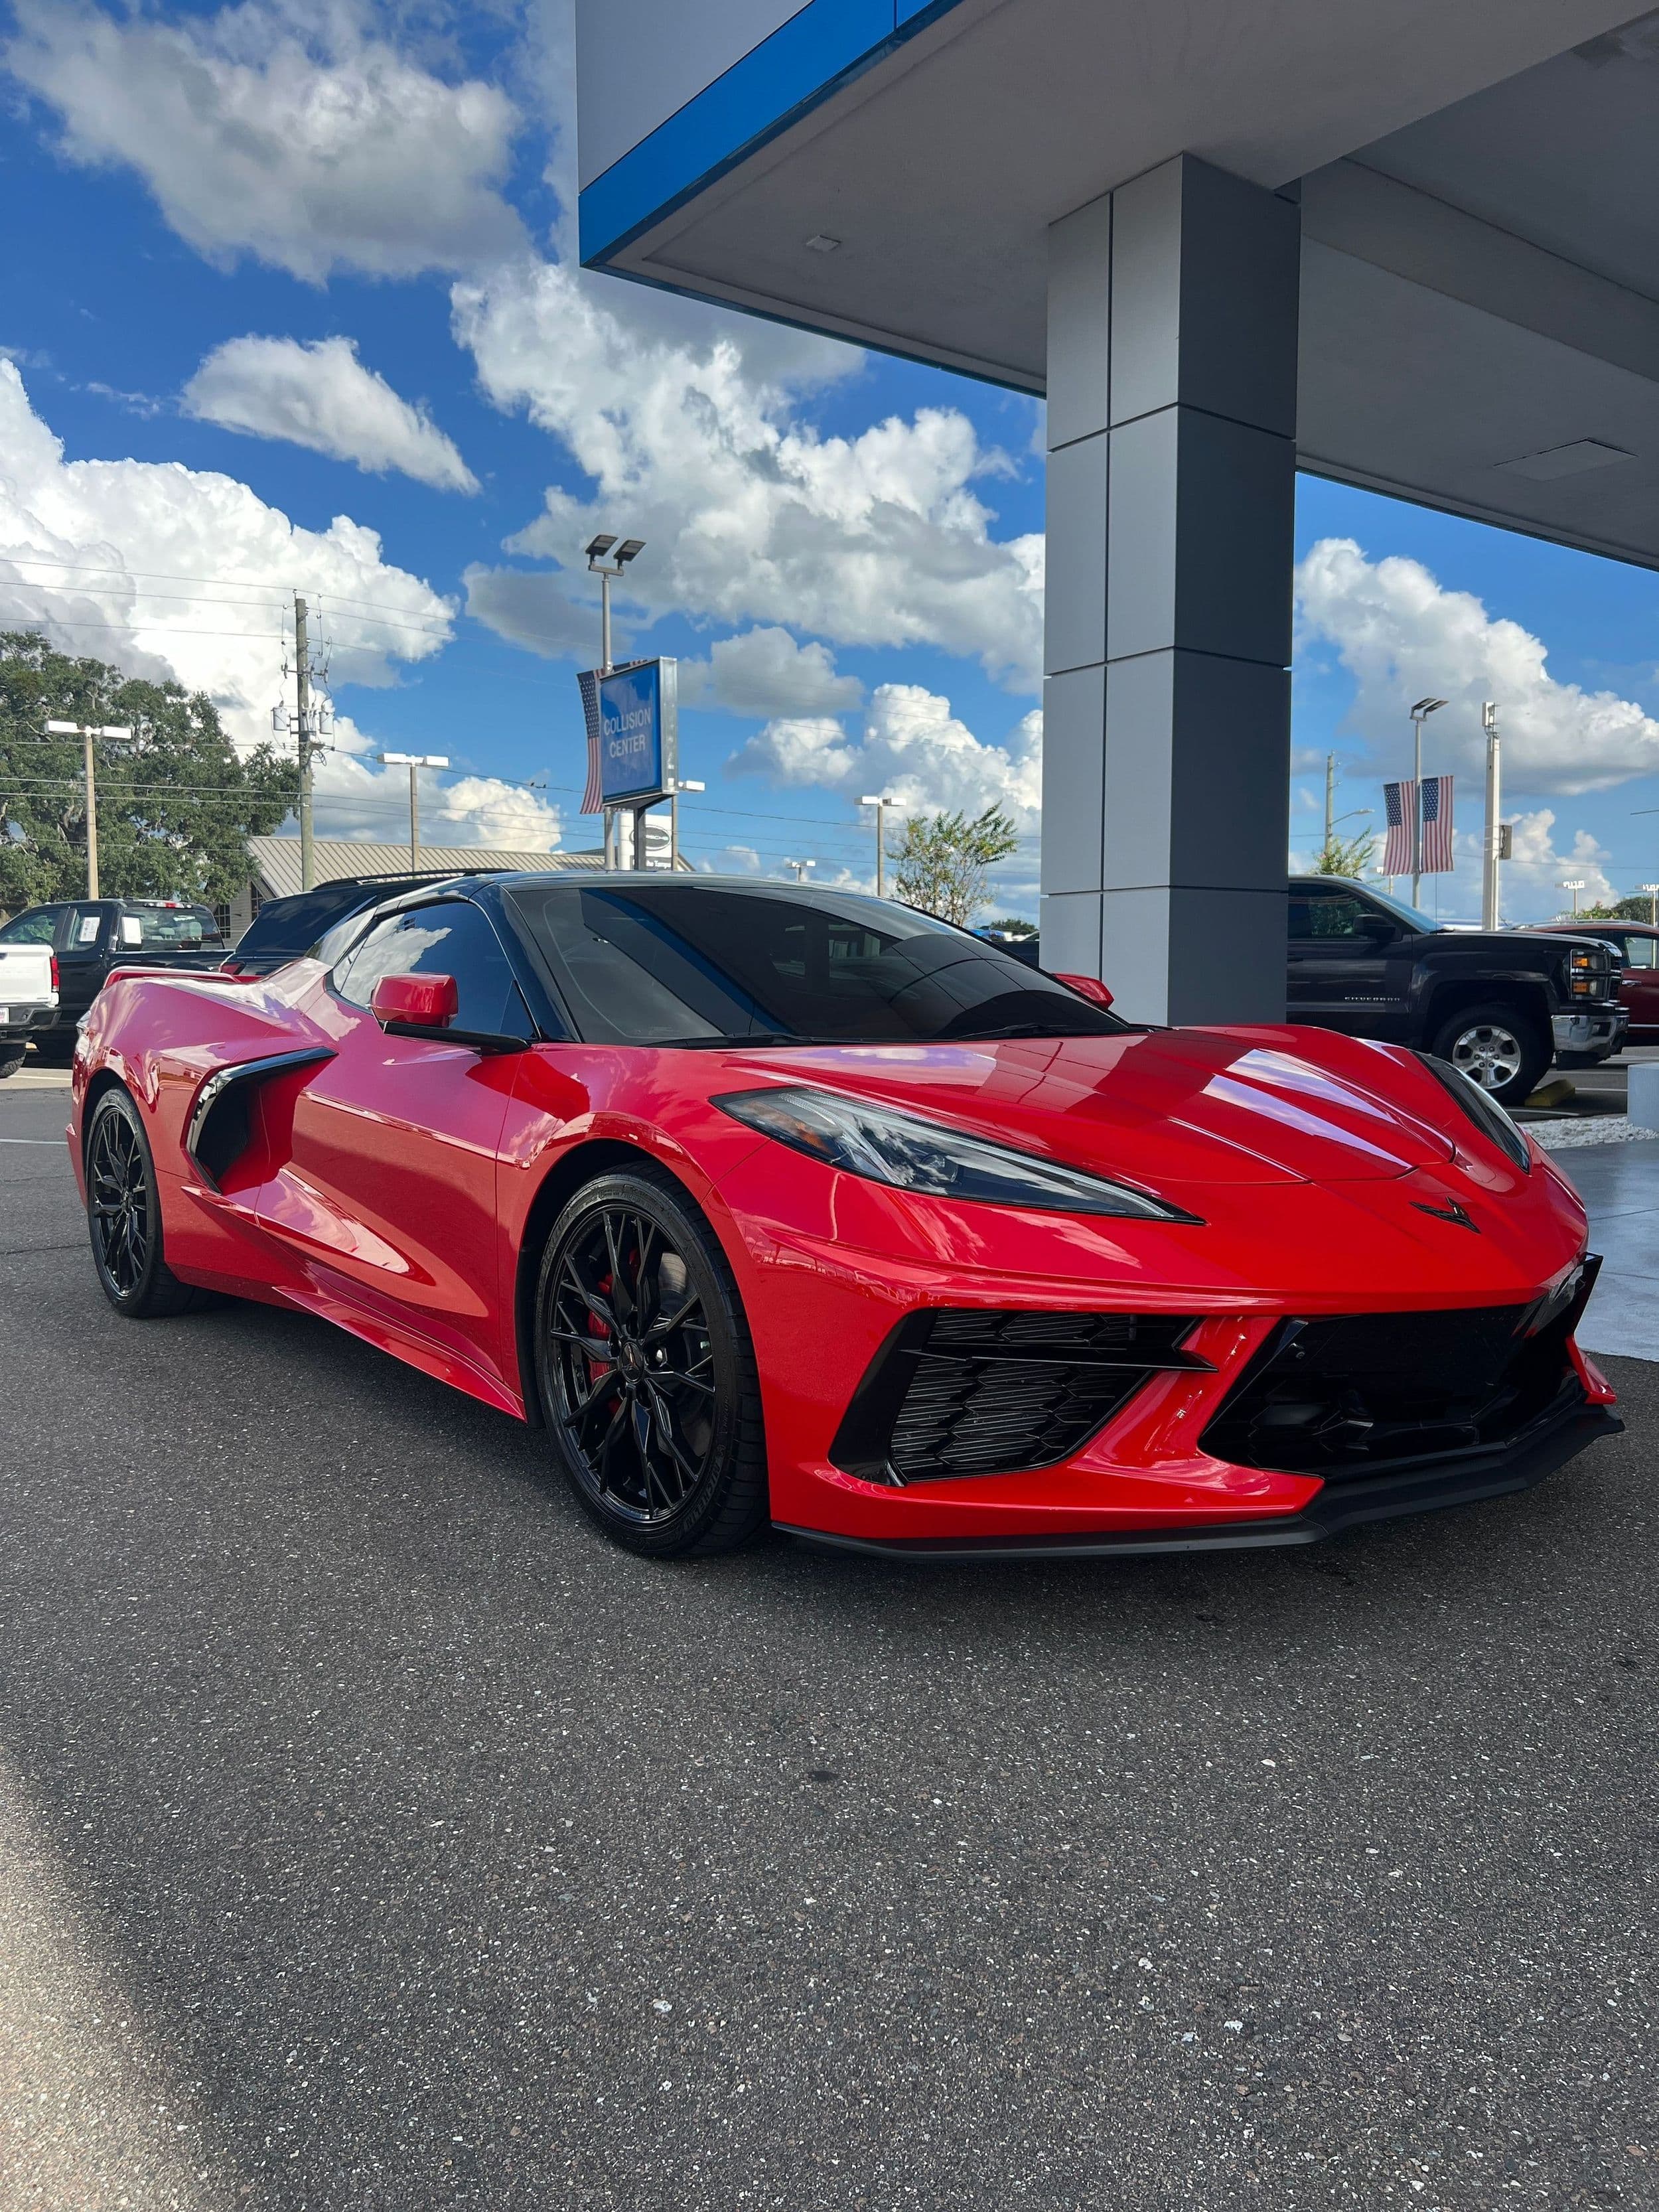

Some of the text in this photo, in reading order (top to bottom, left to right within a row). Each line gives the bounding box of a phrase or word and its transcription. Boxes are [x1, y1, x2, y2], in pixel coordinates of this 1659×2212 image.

[604, 707, 651, 736] COLLISION
[610, 734, 646, 758] CENTER
[684, 1461, 721, 1530] MICHELIN
